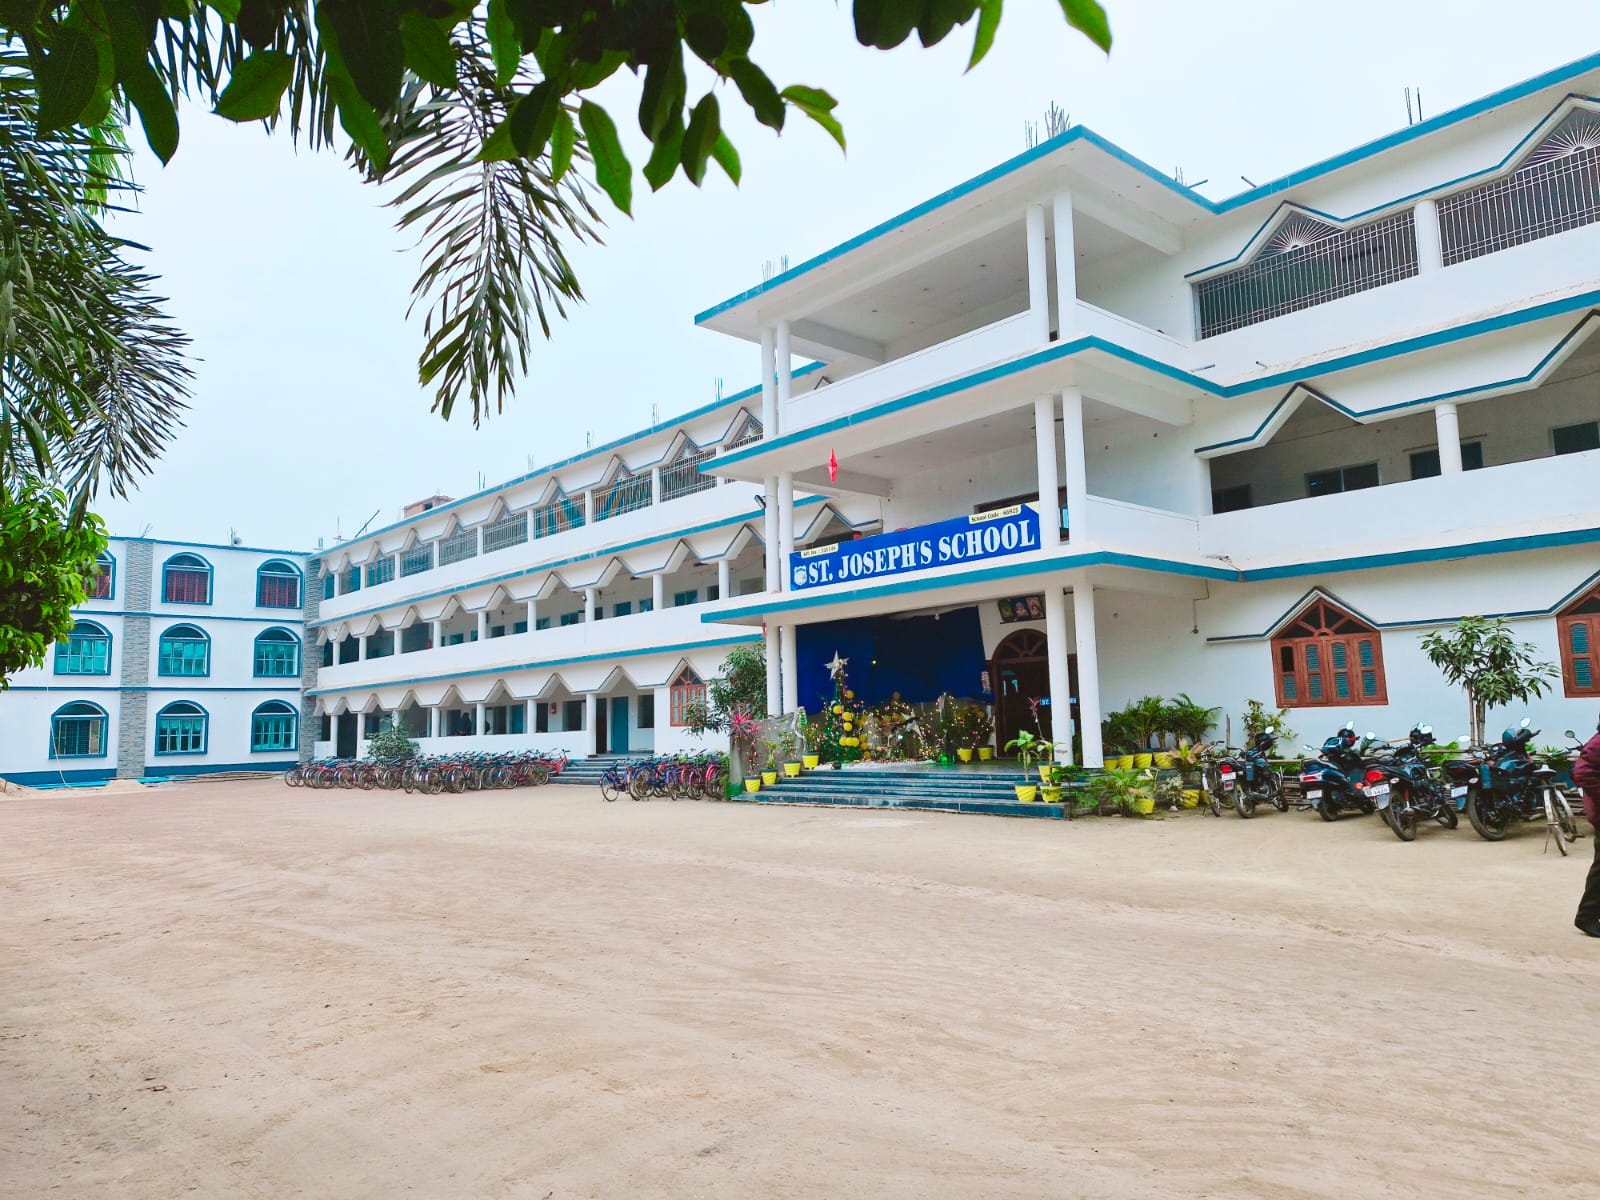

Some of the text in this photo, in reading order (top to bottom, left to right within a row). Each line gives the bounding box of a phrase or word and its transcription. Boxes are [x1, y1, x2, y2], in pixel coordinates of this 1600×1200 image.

[808, 519, 1035, 585] ST. JOSEPH'S SCHOOL
